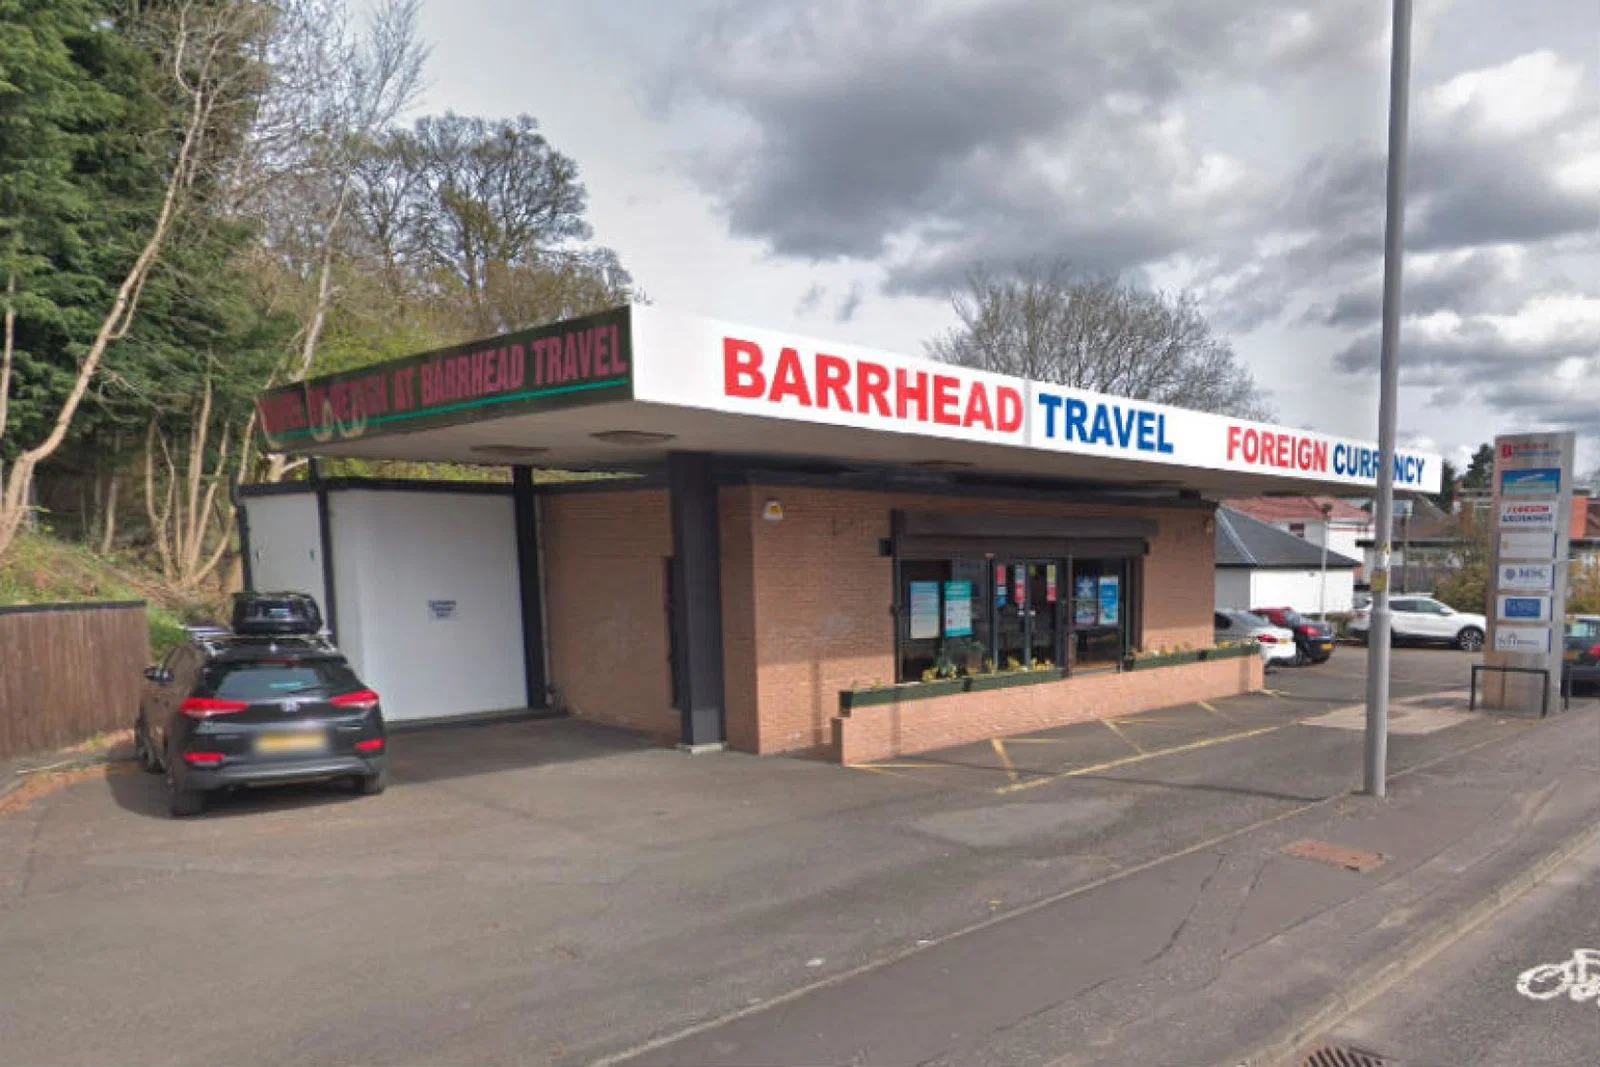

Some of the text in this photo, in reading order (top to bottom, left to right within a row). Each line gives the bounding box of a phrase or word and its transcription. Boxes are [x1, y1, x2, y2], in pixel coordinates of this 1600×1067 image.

[394, 367, 414, 409] AT
[421, 345, 524, 405] BARRHEAD
[534, 325, 628, 385] TRAVEL
[722, 336, 1425, 484] BARRHEAD TRAVEL FOREIGN CURRNCY
